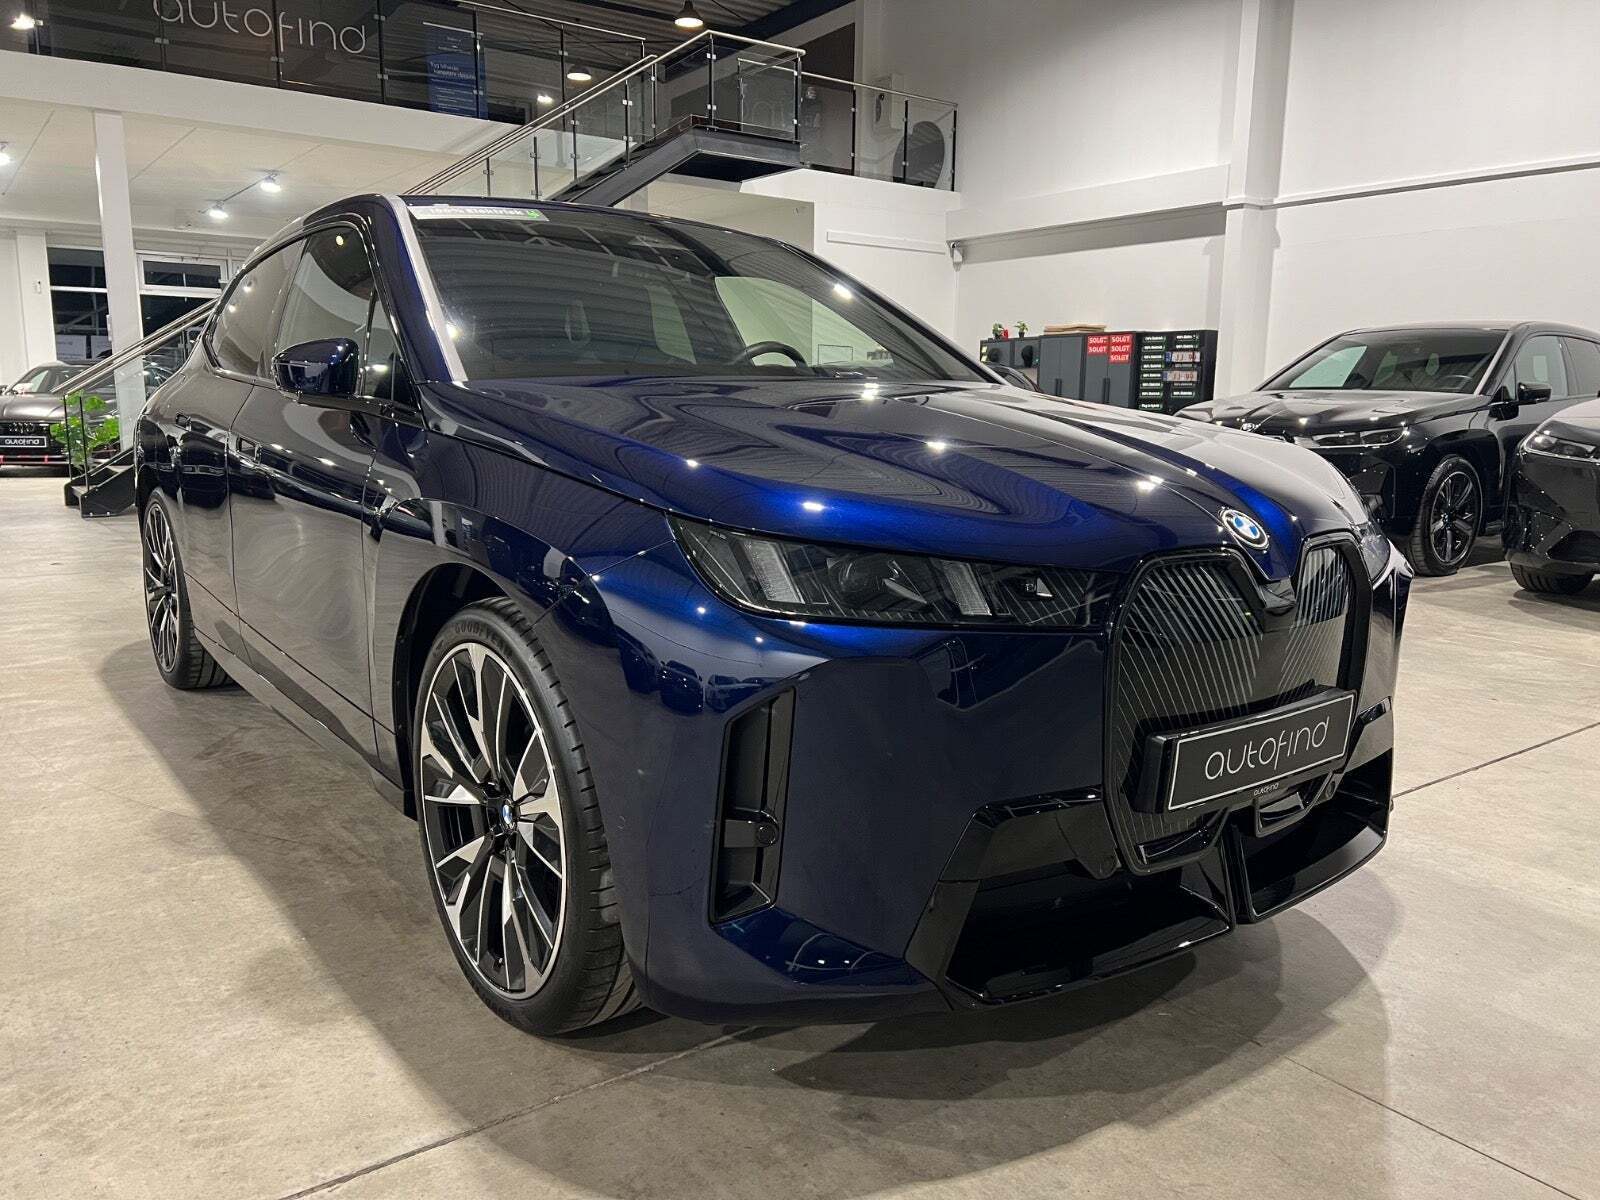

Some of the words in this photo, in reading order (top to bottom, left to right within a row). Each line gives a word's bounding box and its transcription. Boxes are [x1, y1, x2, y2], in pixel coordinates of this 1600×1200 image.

[153, 0, 366, 54] autofind
[1111, 335, 1130, 343] SOLGT
[1088, 345, 1106, 353] SOLGT
[1111, 344, 1130, 352] SOLGT
[1204, 715, 1330, 780] autofind
